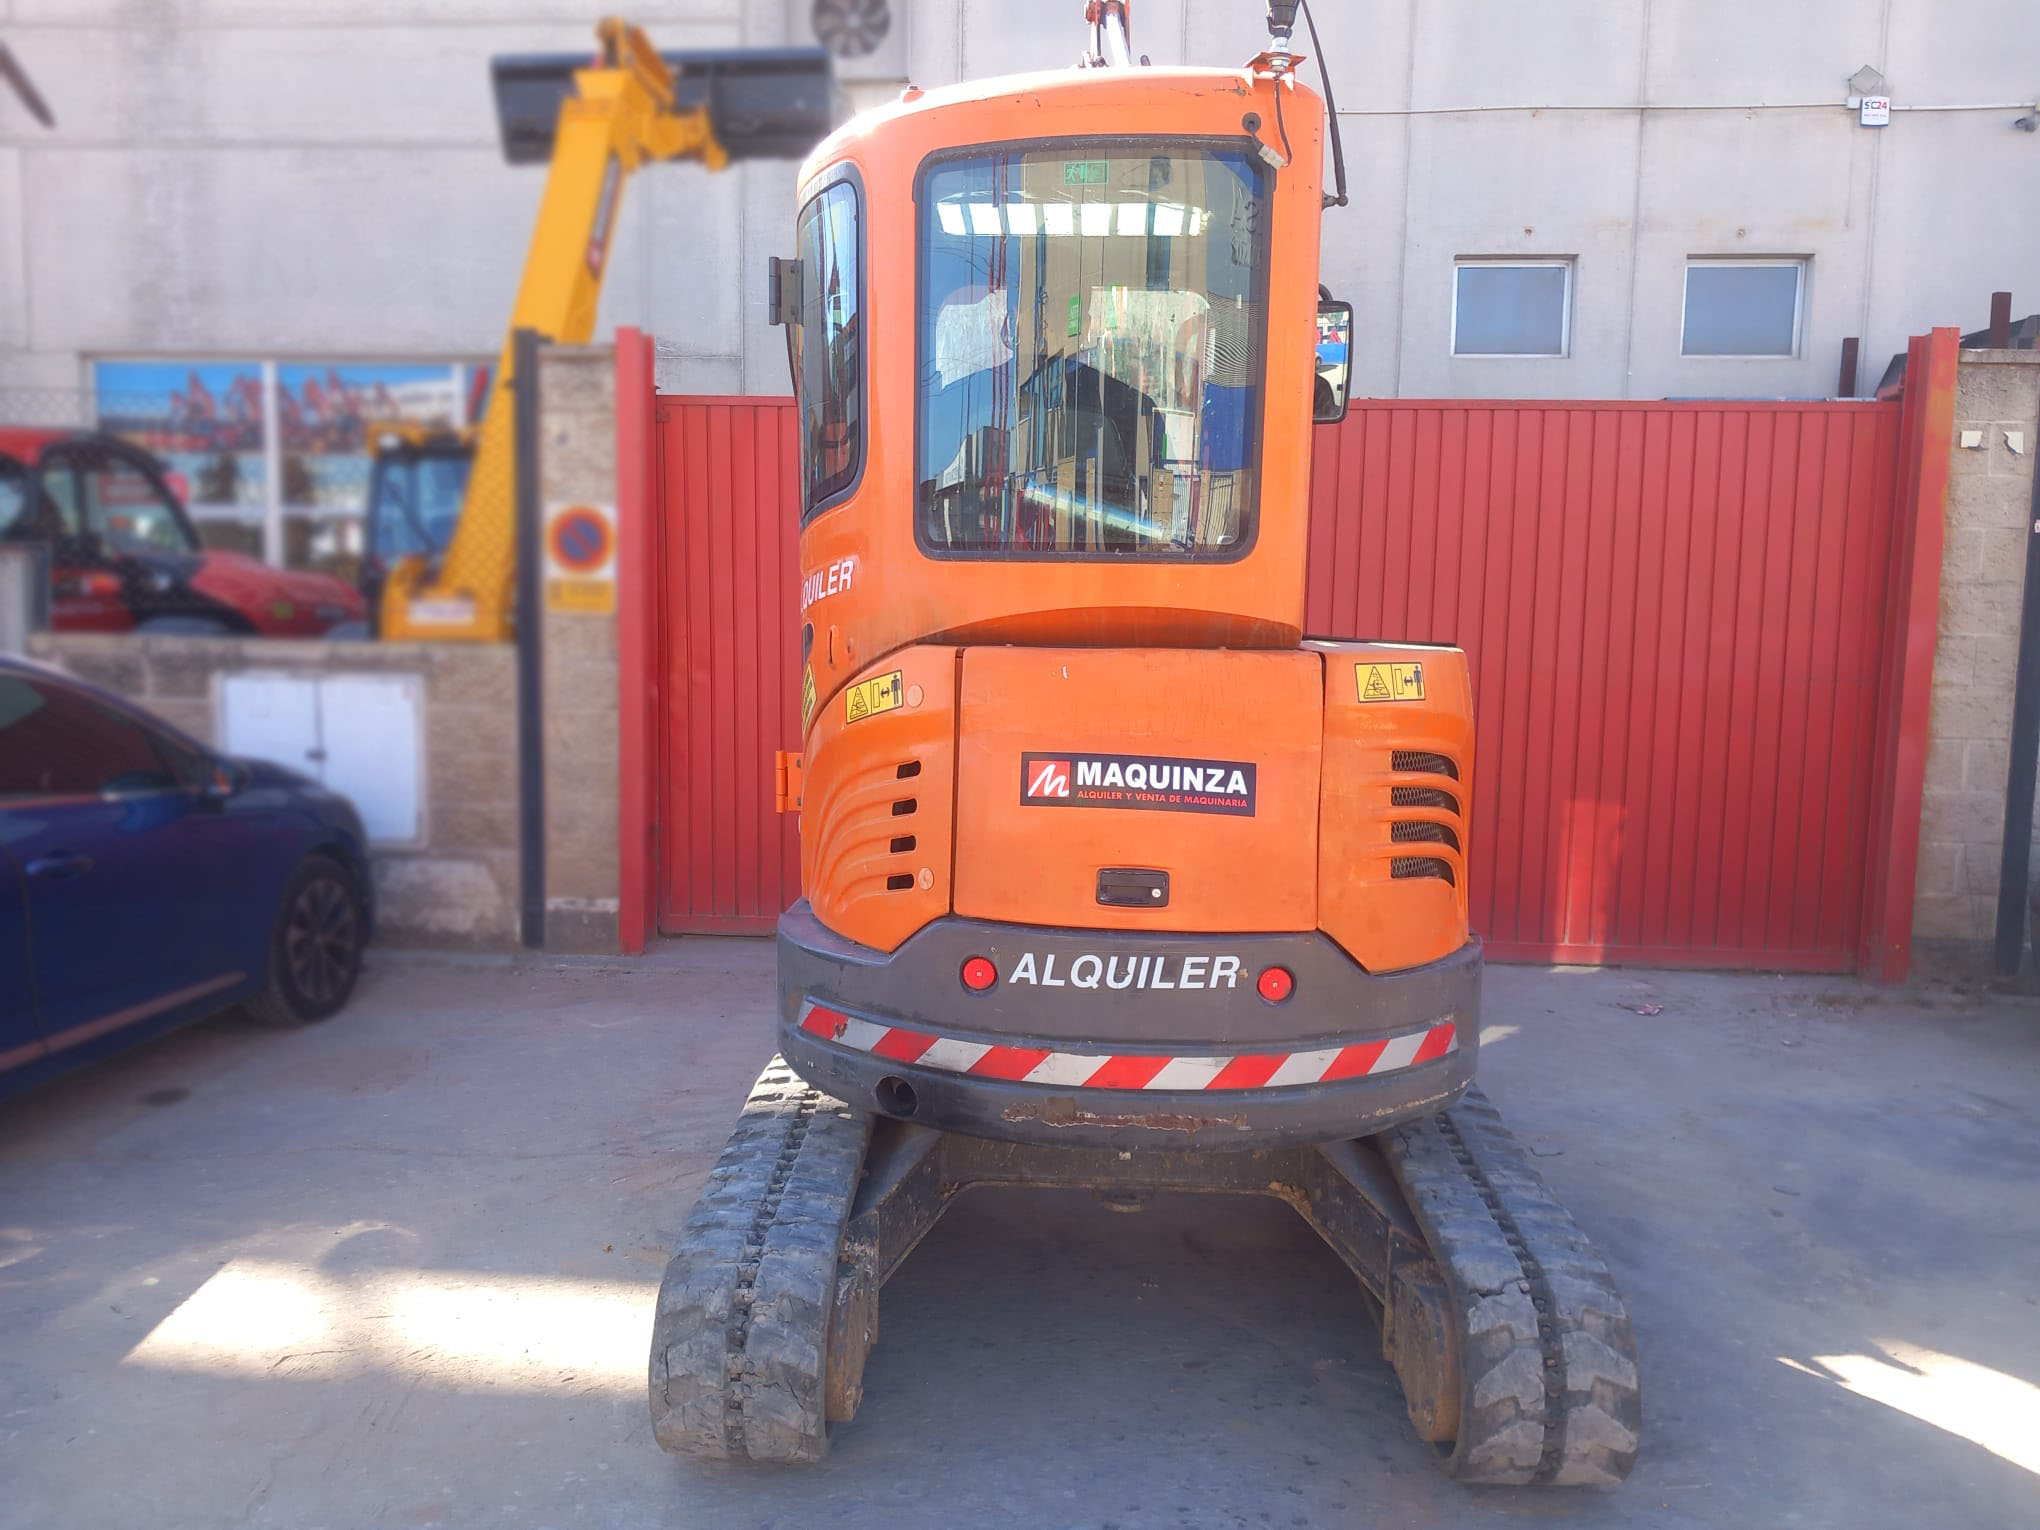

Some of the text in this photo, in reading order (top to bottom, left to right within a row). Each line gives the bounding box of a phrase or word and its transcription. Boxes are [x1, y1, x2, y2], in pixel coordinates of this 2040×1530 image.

[1077, 761, 1248, 795] MAQUINZA
[1077, 790, 1248, 807] ALQUILER Y VENTA DE MAQUINARIA
[1009, 952, 1241, 989] ALQUILER
